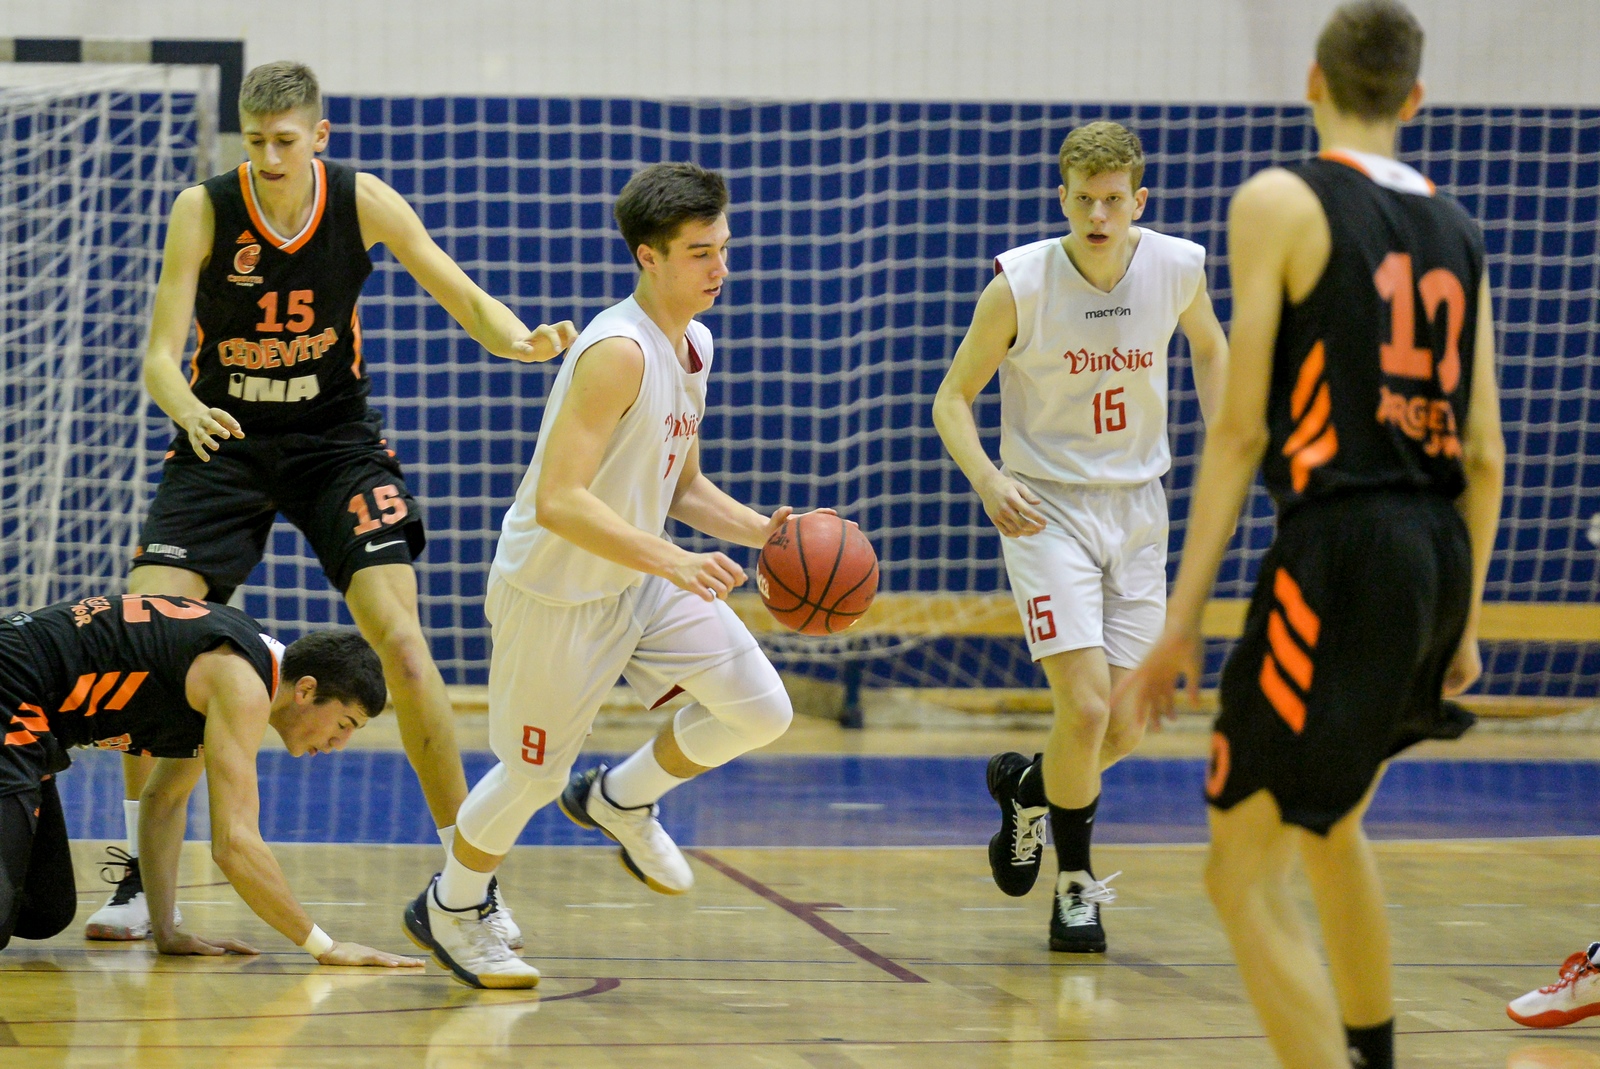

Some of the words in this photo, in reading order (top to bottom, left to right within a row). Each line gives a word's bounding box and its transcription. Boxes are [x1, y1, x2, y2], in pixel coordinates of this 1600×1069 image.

[255, 289, 315, 333] 15
[1085, 307, 1131, 319] macron
[217, 327, 339, 370] CEDEVITA
[1063, 347, 1153, 374] Vindija
[1092, 386, 1127, 435] 15
[346, 484, 408, 536] 15
[1027, 595, 1057, 644] 15
[521, 725, 546, 766] 9
